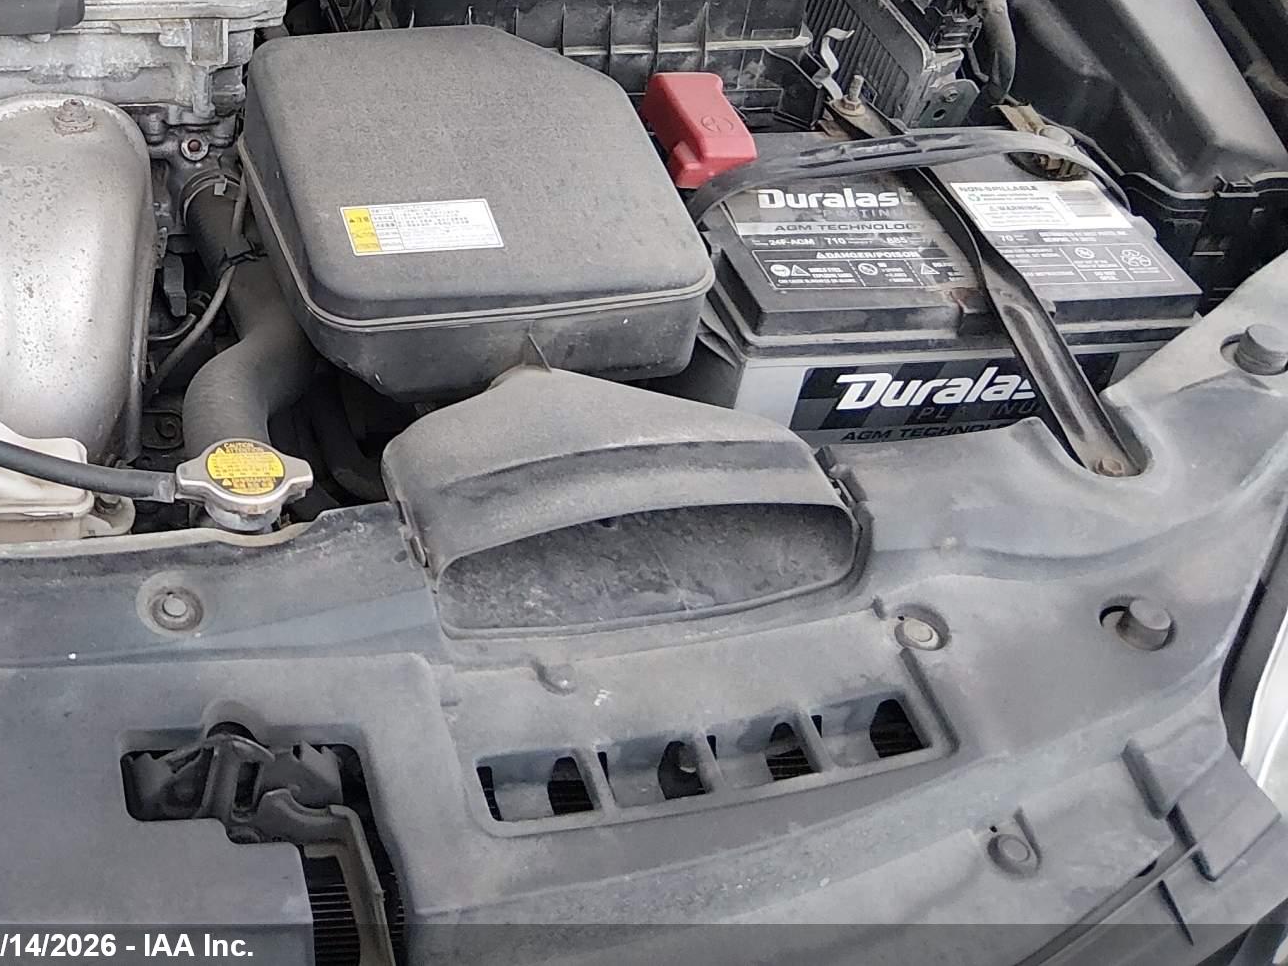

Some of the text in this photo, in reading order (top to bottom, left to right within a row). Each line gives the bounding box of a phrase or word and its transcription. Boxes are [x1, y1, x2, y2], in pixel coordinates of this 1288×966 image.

[758, 187, 917, 209] Duralast
[775, 224, 812, 232] AGM
[824, 236, 846, 245] 710
[835, 367, 1037, 410] Duralas
[840, 429, 892, 442] AGM
